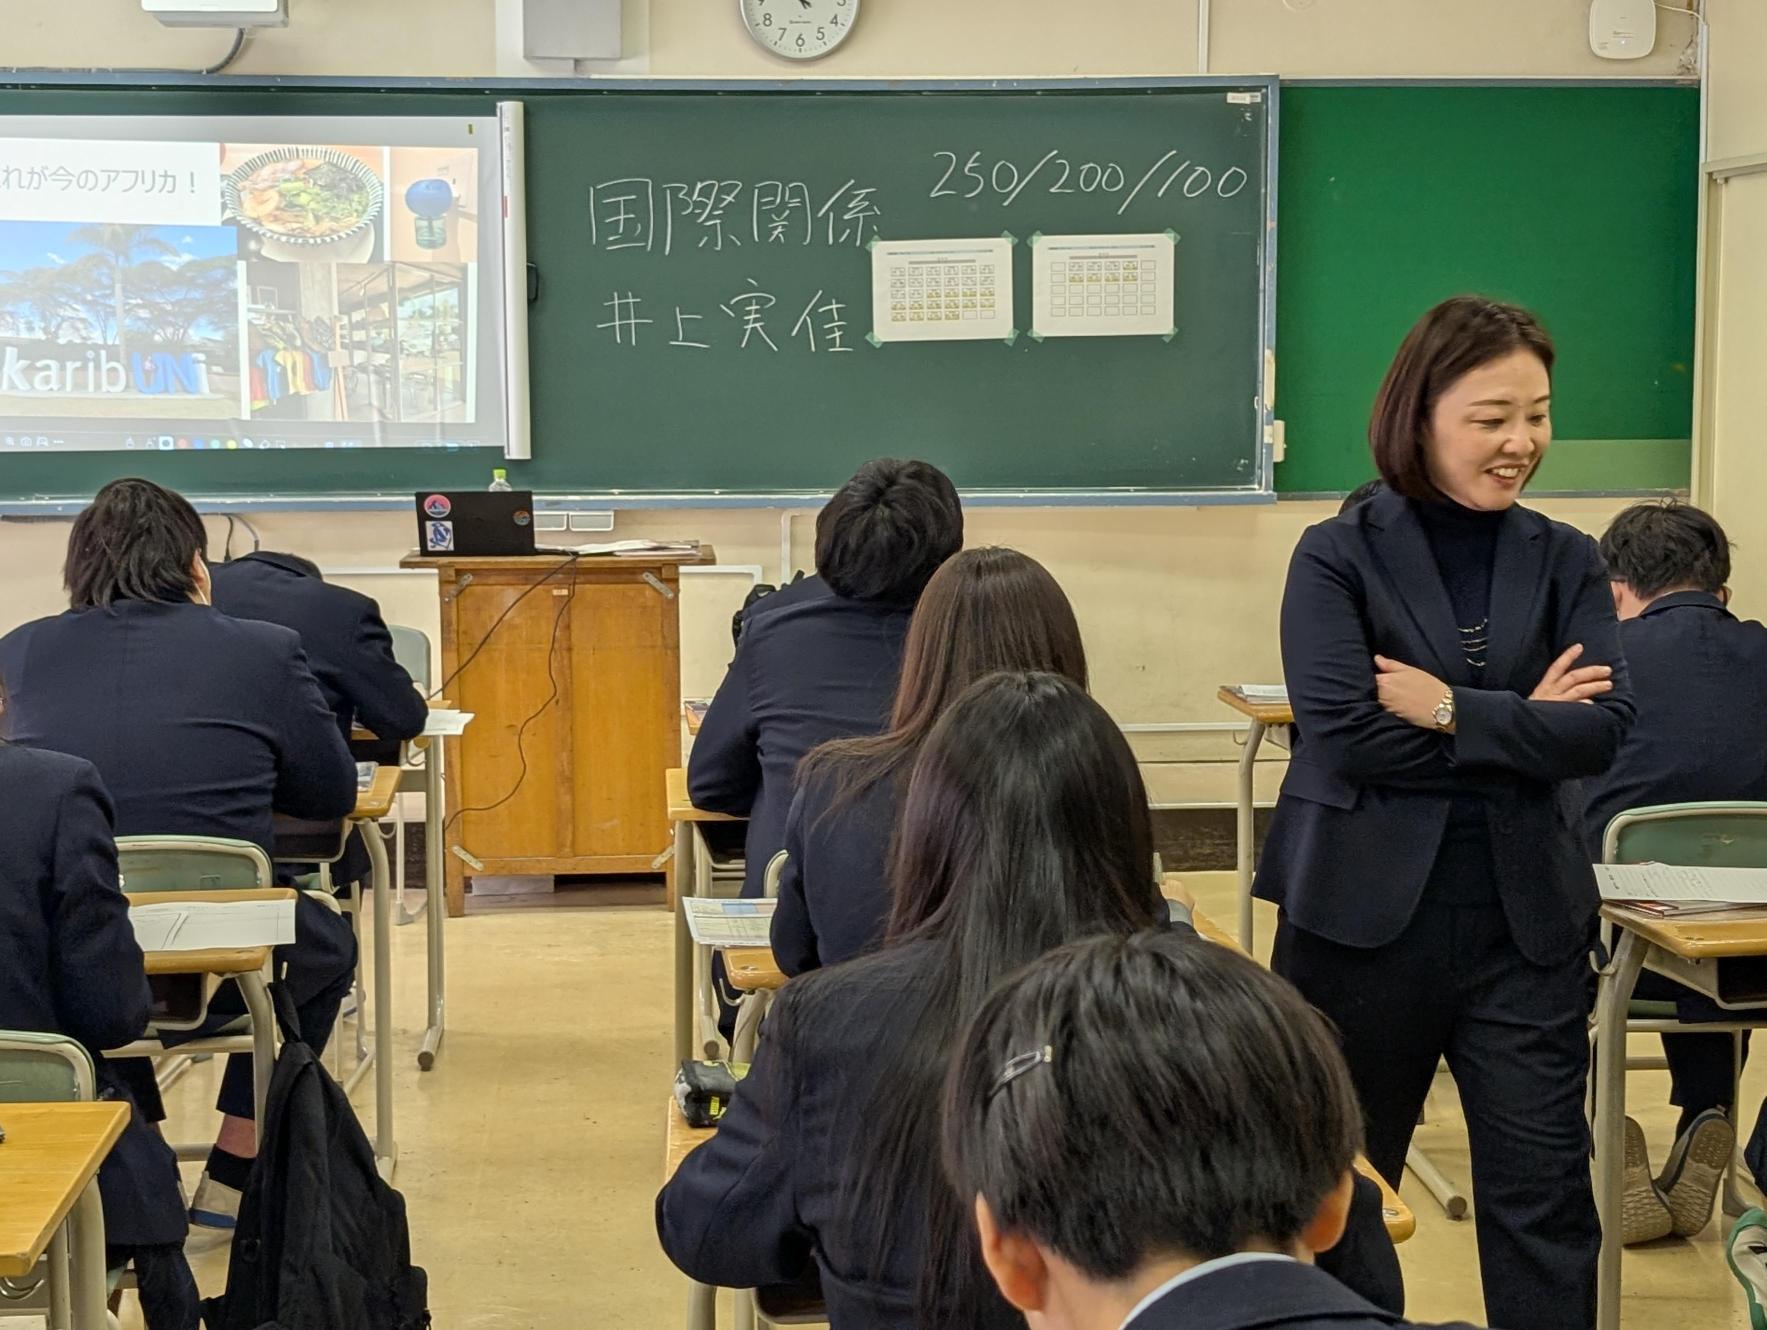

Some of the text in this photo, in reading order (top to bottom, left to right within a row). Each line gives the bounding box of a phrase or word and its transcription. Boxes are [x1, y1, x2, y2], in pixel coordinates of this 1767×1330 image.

[762, 13, 773, 27] 8
[829, 14, 839, 26] 4
[778, 28, 787, 41] 7
[795, 33, 805, 47] 6
[815, 27, 825, 40] 5
[0, 165, 196, 194] れが今のアフリカ！
[589, 178, 881, 256] 国際関係
[596, 278, 854, 352] 井上実佳
